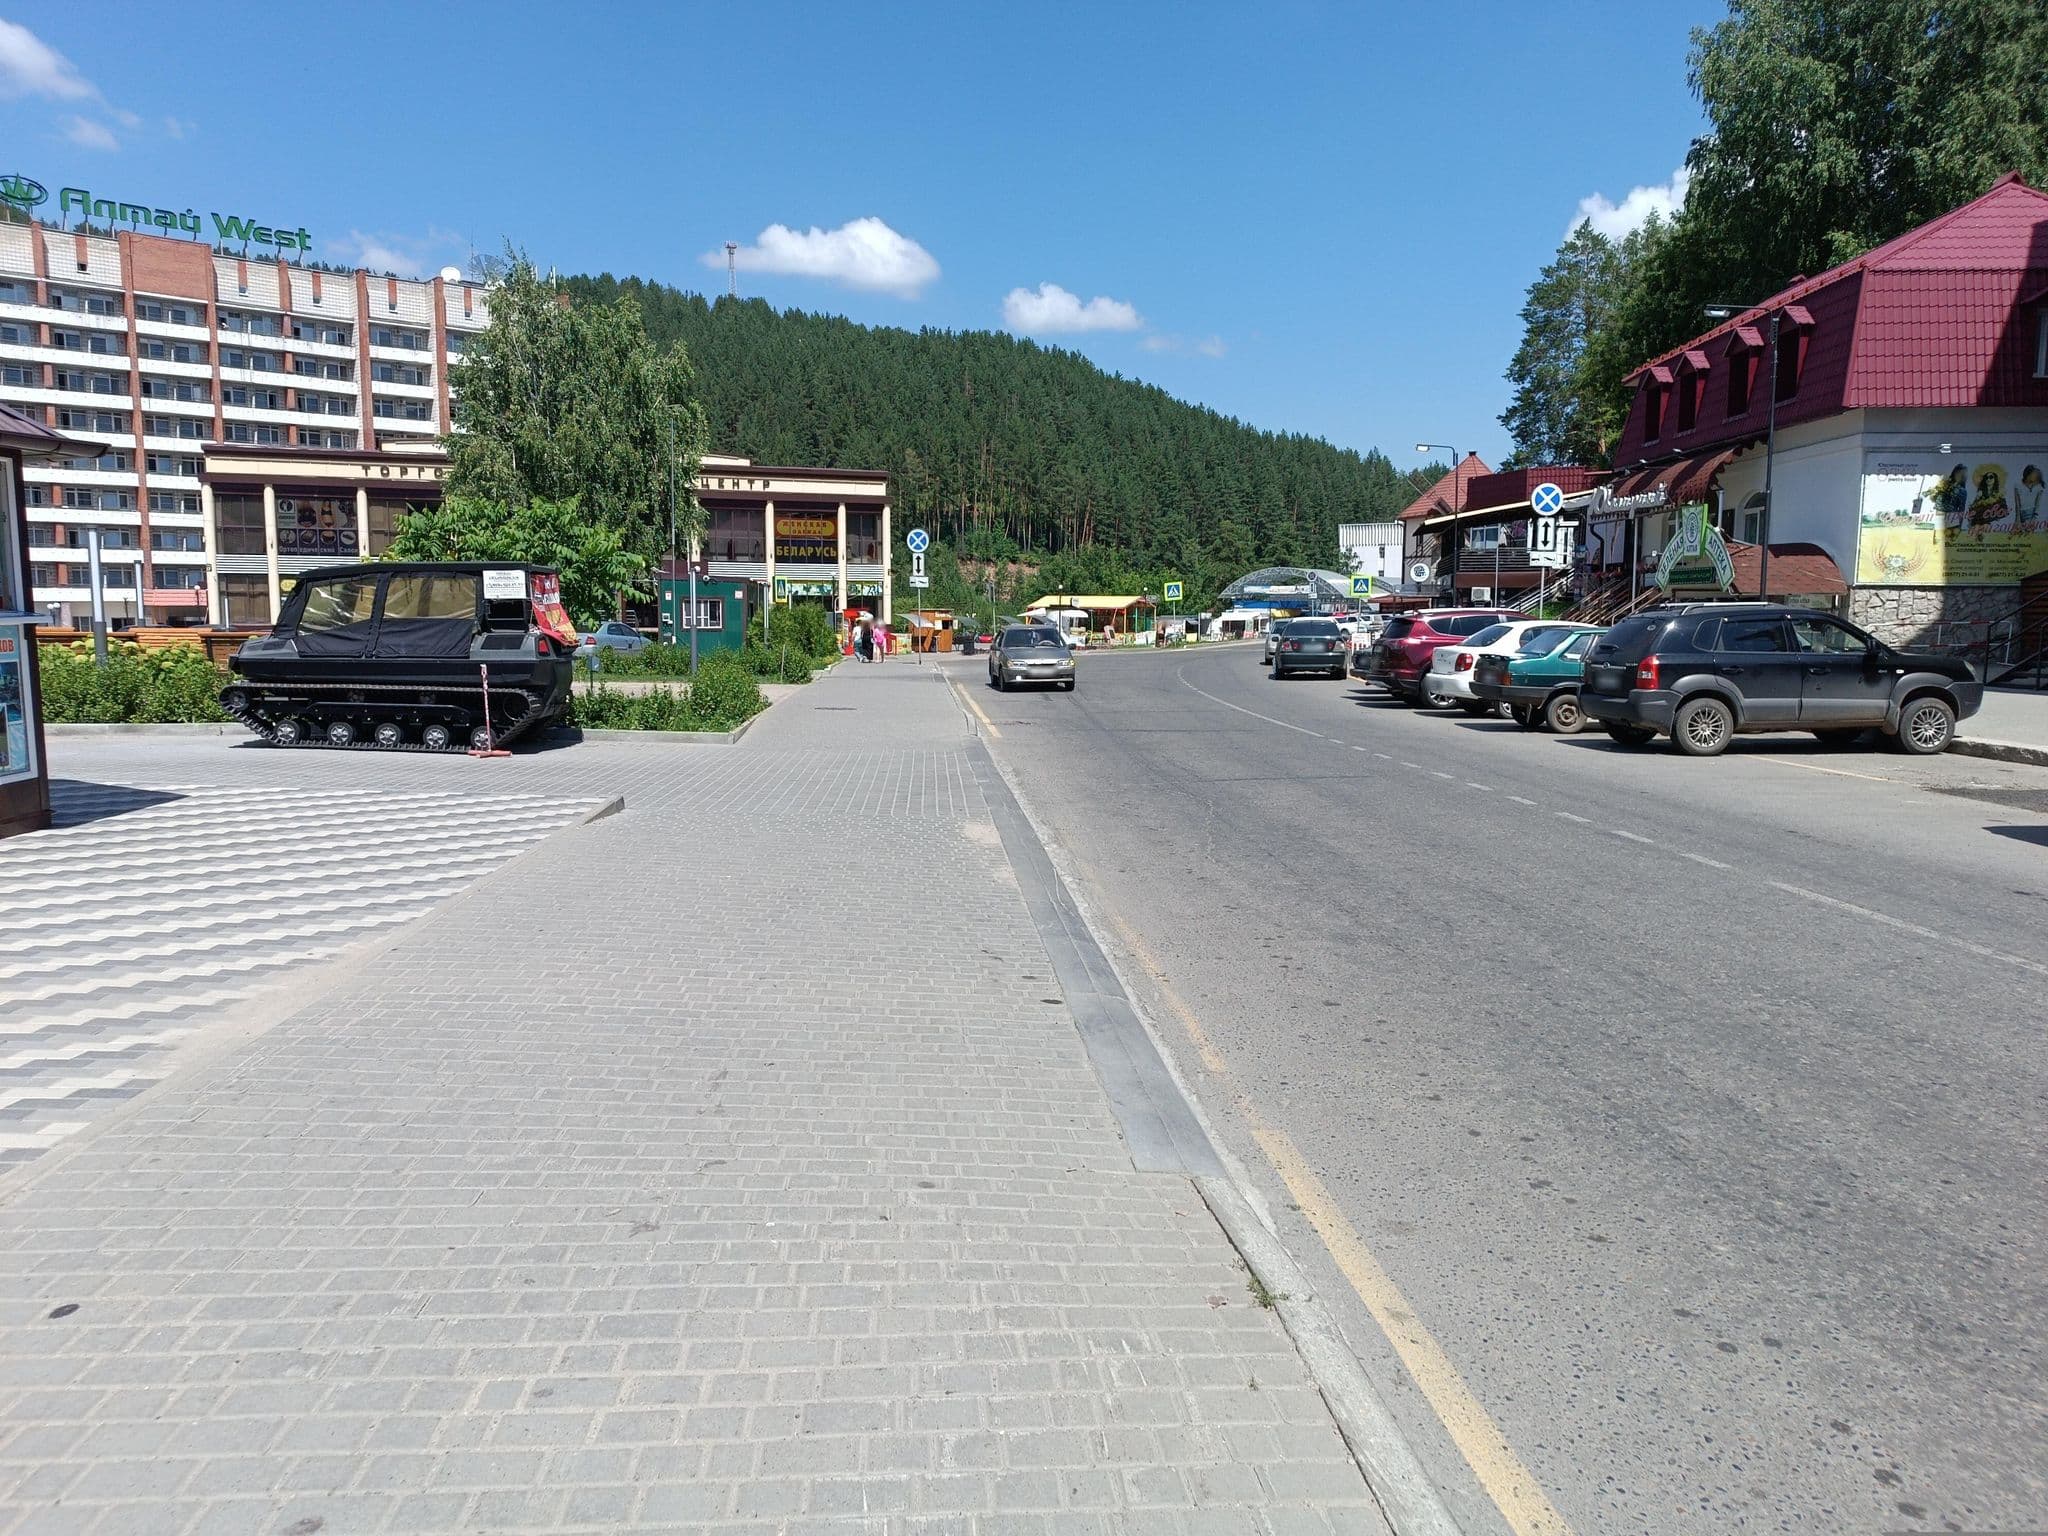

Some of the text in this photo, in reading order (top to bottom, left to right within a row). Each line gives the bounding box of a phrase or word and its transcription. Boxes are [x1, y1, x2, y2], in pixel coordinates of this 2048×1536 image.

[60, 187, 312, 251] Алтай West
[361, 464, 770, 491] ТОРГО ЦЕНТР
[776, 546, 837, 557] БЕЛАРУСЬ
[1708, 535, 1728, 576] АПТЕКА
